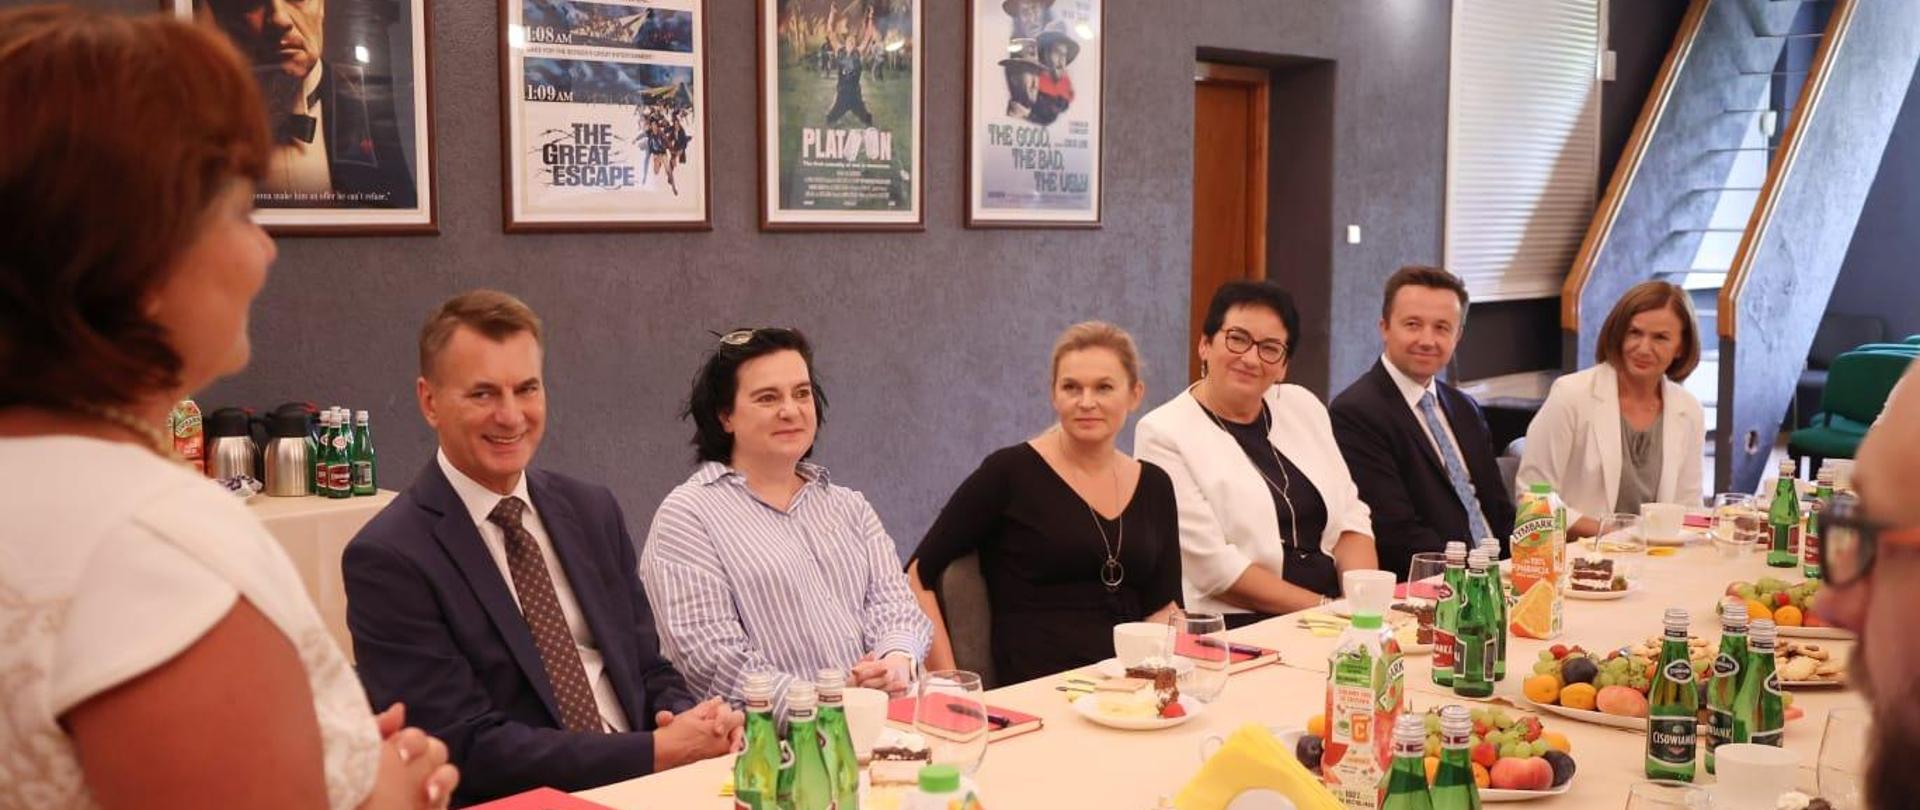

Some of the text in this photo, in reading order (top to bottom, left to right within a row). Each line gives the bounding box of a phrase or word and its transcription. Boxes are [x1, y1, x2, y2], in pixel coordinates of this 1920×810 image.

[526, 26, 572, 44] 1:08 AM
[527, 85, 574, 102] 1:09 AM
[571, 123, 612, 145] THE
[988, 123, 1013, 146] THE
[542, 143, 611, 165] GREAT
[1012, 148, 1036, 170] THE
[552, 165, 635, 187] ESCAPE
[1034, 171, 1058, 192] THE
[1653, 730, 1696, 746] CISOWIANK
